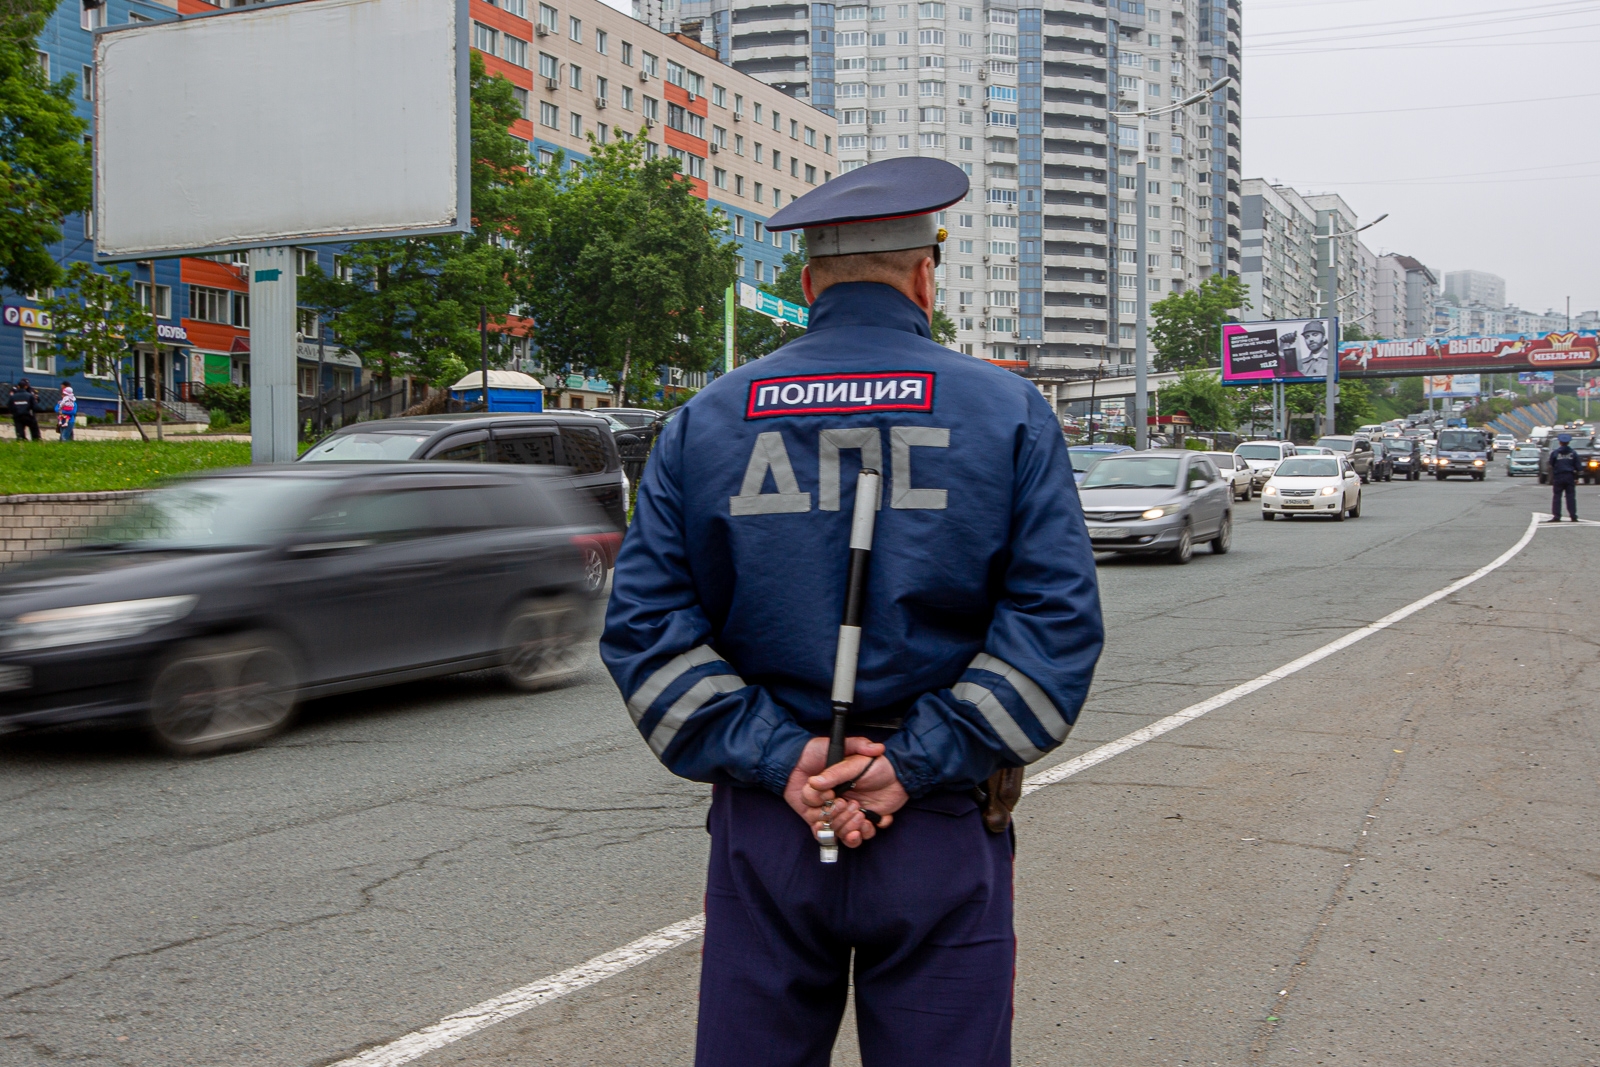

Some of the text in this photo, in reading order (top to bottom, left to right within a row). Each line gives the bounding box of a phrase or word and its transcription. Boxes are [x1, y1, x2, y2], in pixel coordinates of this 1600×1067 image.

[157, 324, 187, 340] ОБУВЬ
[1376, 338, 1500, 358] УМНЫЙ ВЫБОР
[1534, 351, 1591, 361] МЕБЕЛЬ-ГРАД
[1260, 360, 1278, 368] TELE2
[757, 379, 923, 406] ПОЛИЦИЯ
[729, 426, 951, 517] ДПС
